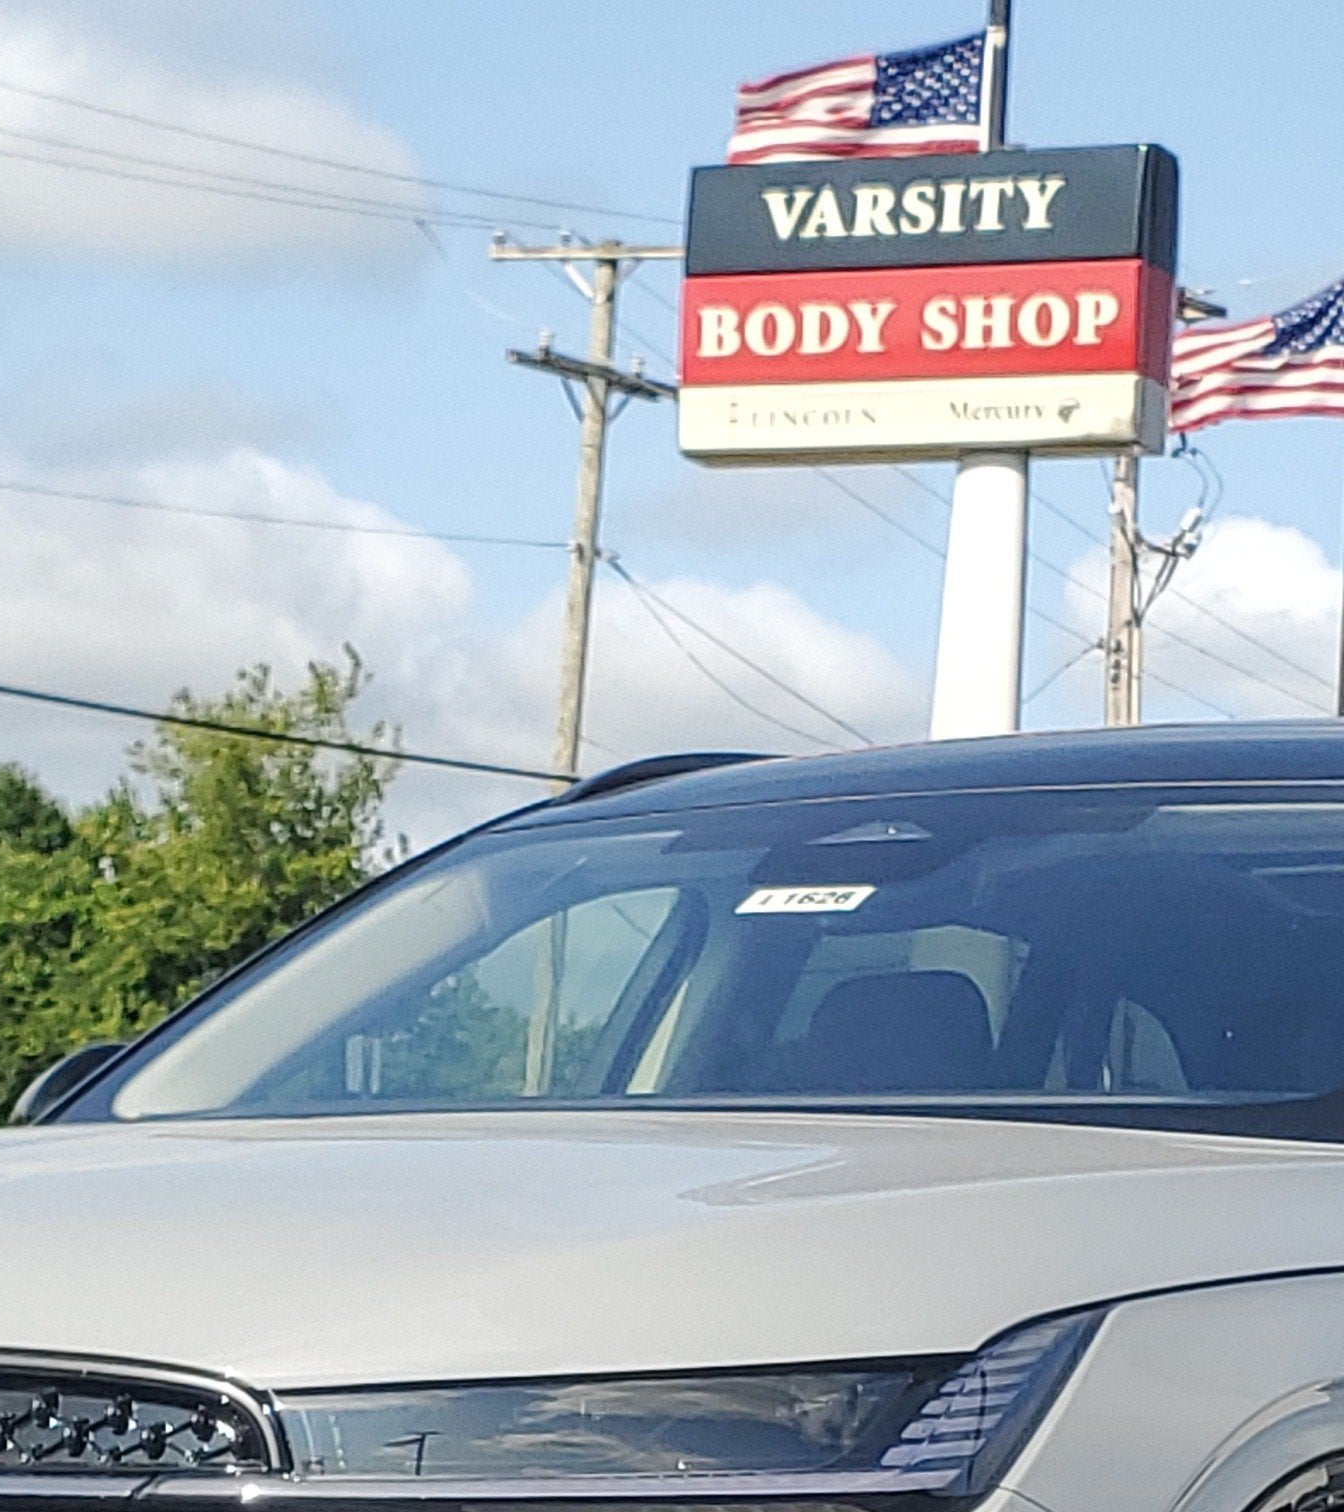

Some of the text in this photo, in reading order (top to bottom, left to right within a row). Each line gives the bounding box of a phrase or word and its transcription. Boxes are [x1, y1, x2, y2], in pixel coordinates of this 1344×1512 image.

[761, 174, 1067, 241] VARSITY
[695, 291, 1120, 359] BODY SHOP
